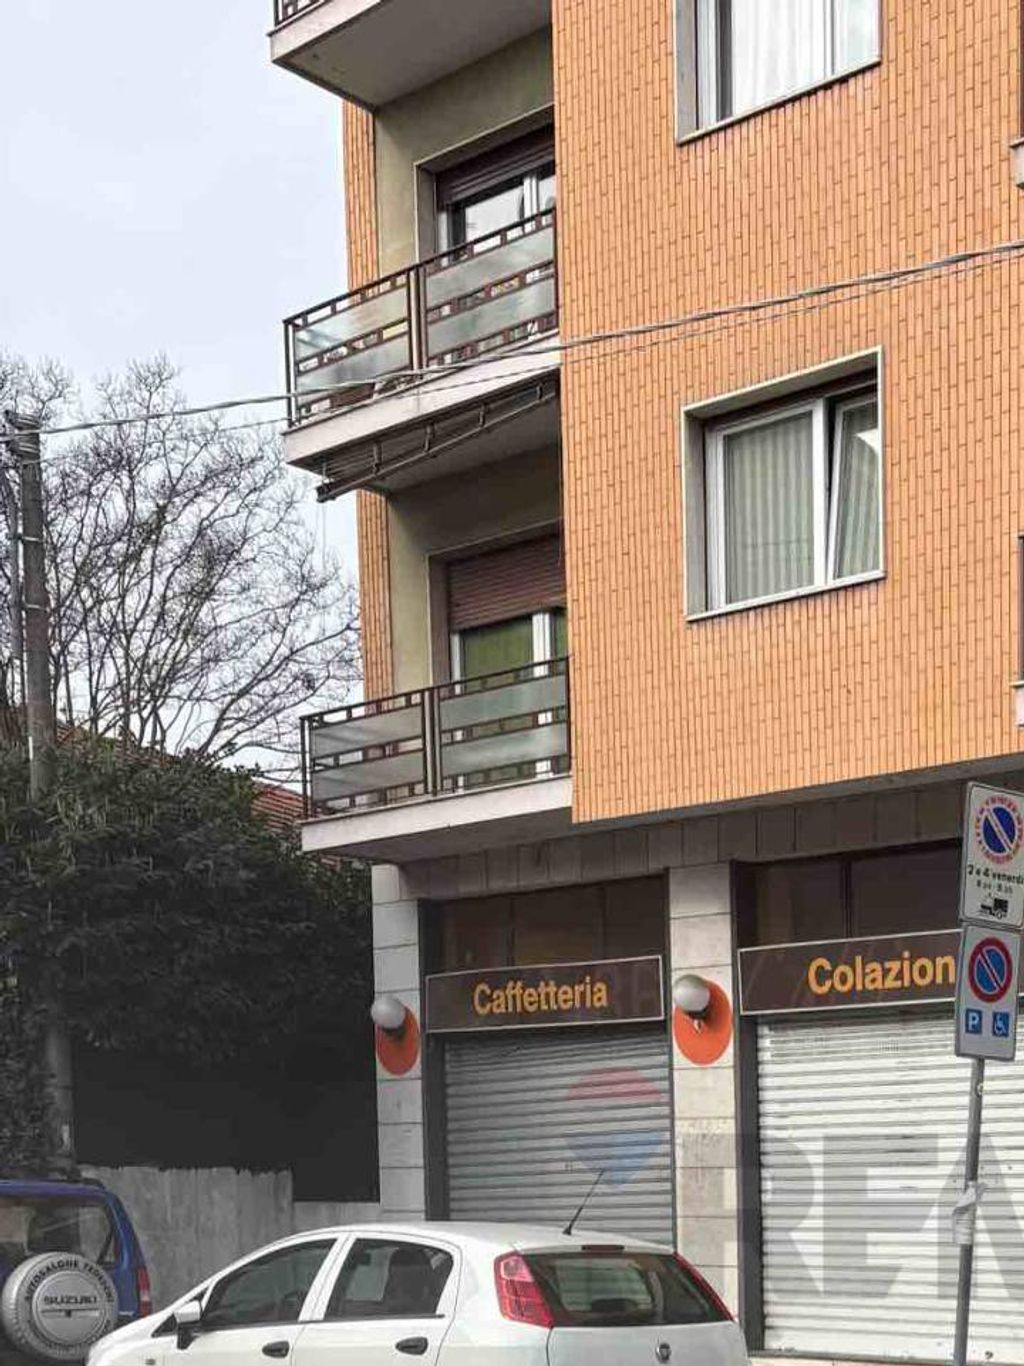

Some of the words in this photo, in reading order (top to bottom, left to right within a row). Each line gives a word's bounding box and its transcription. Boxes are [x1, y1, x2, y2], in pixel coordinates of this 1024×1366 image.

[808, 951, 956, 995] Colazion
[473, 976, 608, 1015] Caffetteria
[968, 1012, 979, 1031] P
